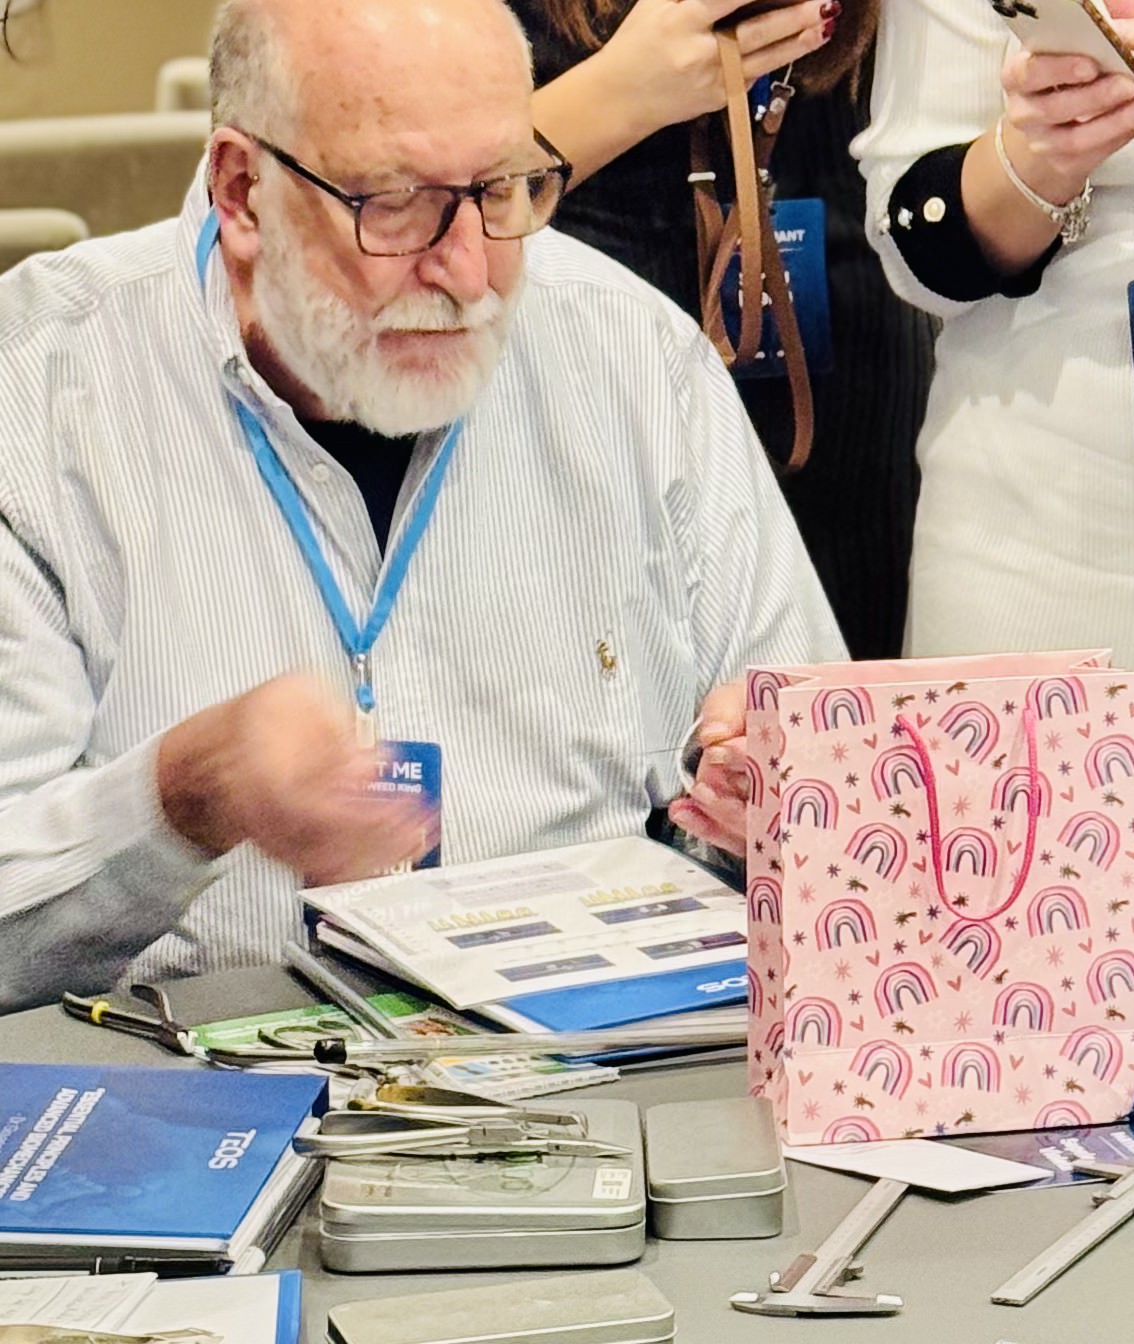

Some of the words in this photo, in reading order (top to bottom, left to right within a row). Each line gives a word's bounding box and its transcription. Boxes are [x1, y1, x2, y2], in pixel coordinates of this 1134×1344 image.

[391, 761, 423, 780] ME
[696, 975, 748, 992] OS
[33, 1087, 79, 1133] ADVANCED
[207, 1128, 257, 1170] TEOS
[9, 1180, 38, 1201] AND
